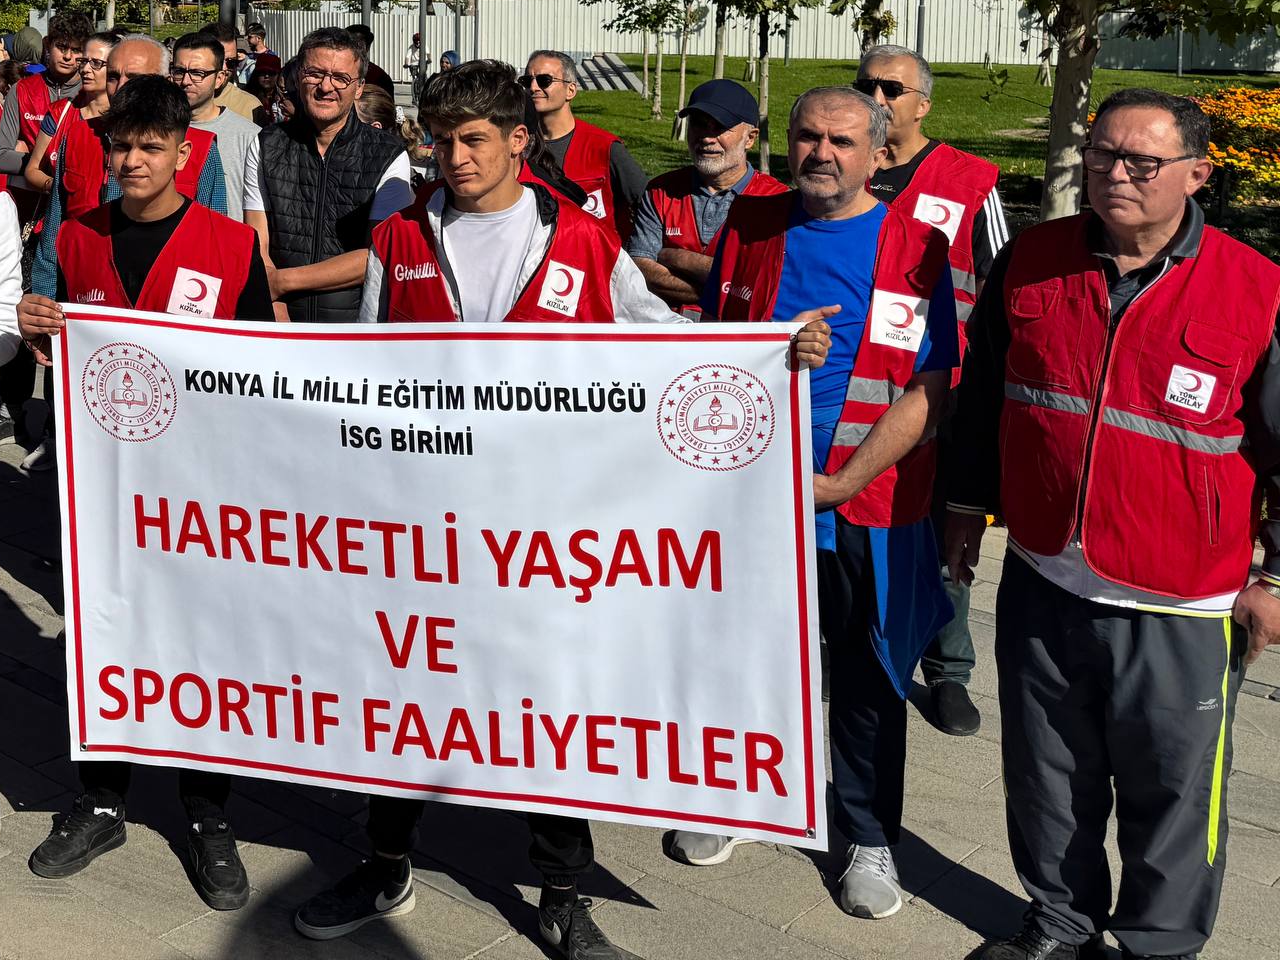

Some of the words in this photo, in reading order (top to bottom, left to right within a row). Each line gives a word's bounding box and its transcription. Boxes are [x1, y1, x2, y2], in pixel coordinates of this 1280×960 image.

[394, 262, 438, 281] Gönüllü
[180, 304, 202, 314] KIZILAY
[546, 299, 569, 312] KIZILAY
[886, 332, 911, 342] KIZILAY
[184, 368, 265, 397] KONYA
[272, 371, 294, 401] İL
[302, 376, 368, 405] MİLLİ
[378, 378, 465, 411] EĞİTİM
[474, 381, 647, 413] MÜDÜRLÜĞÜ
[1170, 394, 1203, 408] KIZILAY
[340, 418, 382, 450] İSG
[391, 423, 474, 456] BİRİMİ
[133, 493, 460, 585] HAREKETLİ
[480, 527, 722, 604] YAŞAM
[374, 610, 458, 674] VE
[98, 664, 341, 747] SPORTİF
[363, 697, 788, 798] FAALİYETLER
